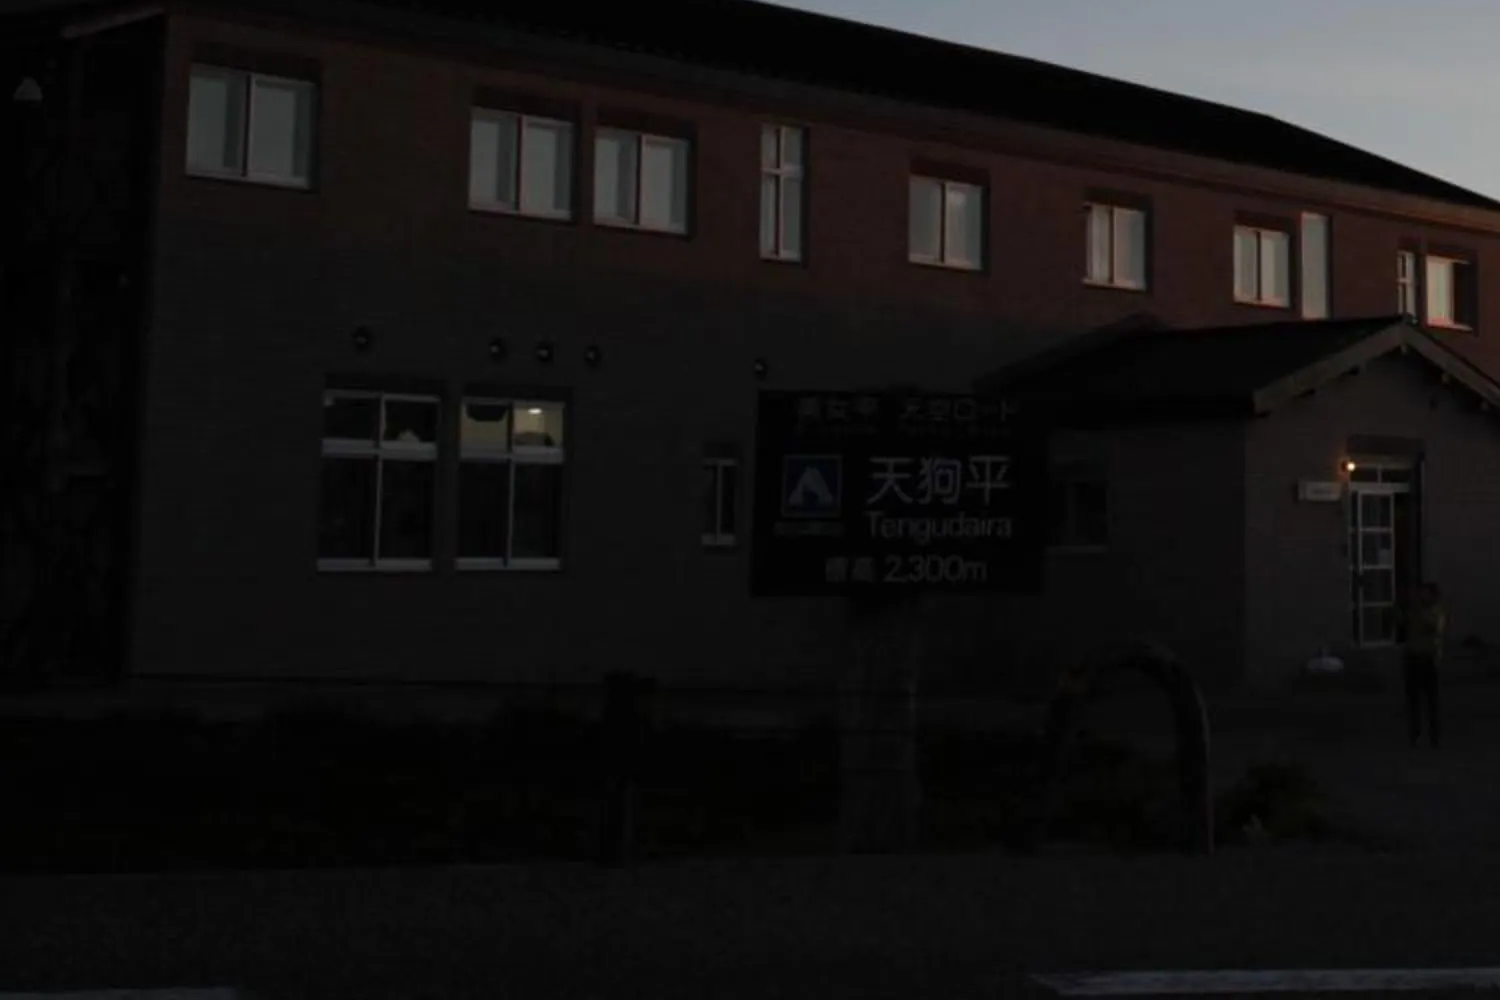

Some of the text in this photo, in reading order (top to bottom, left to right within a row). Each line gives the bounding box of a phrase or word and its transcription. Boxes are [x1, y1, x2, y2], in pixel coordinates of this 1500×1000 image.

[867, 454, 1012, 505] 天狗平
[865, 511, 1012, 544] Tengudaira
